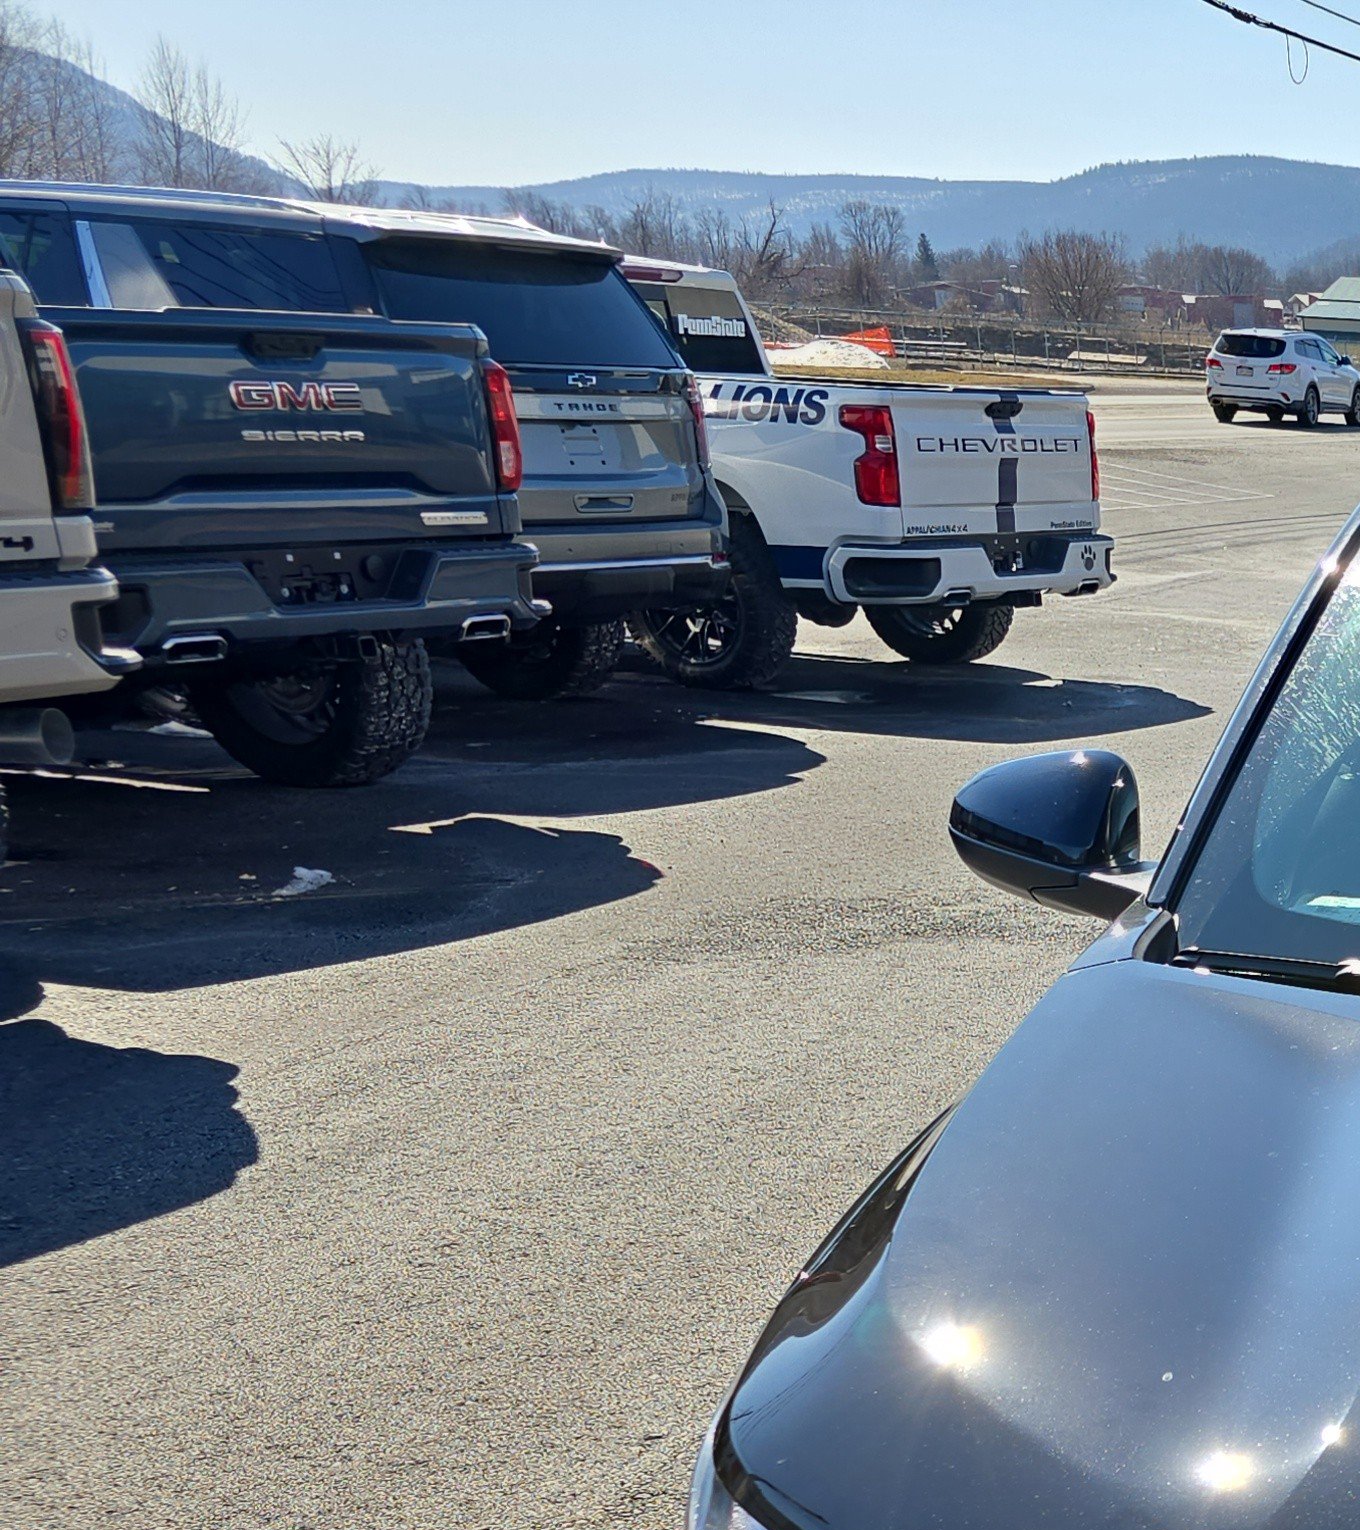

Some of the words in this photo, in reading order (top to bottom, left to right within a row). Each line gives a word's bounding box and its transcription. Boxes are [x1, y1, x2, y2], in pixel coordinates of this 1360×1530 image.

[229, 380, 362, 411] GMC
[553, 402, 618, 413] TAHOE
[703, 384, 829, 426] LIONS
[241, 430, 365, 442] SIERRA
[916, 437, 1082, 453] CHEVROLET
